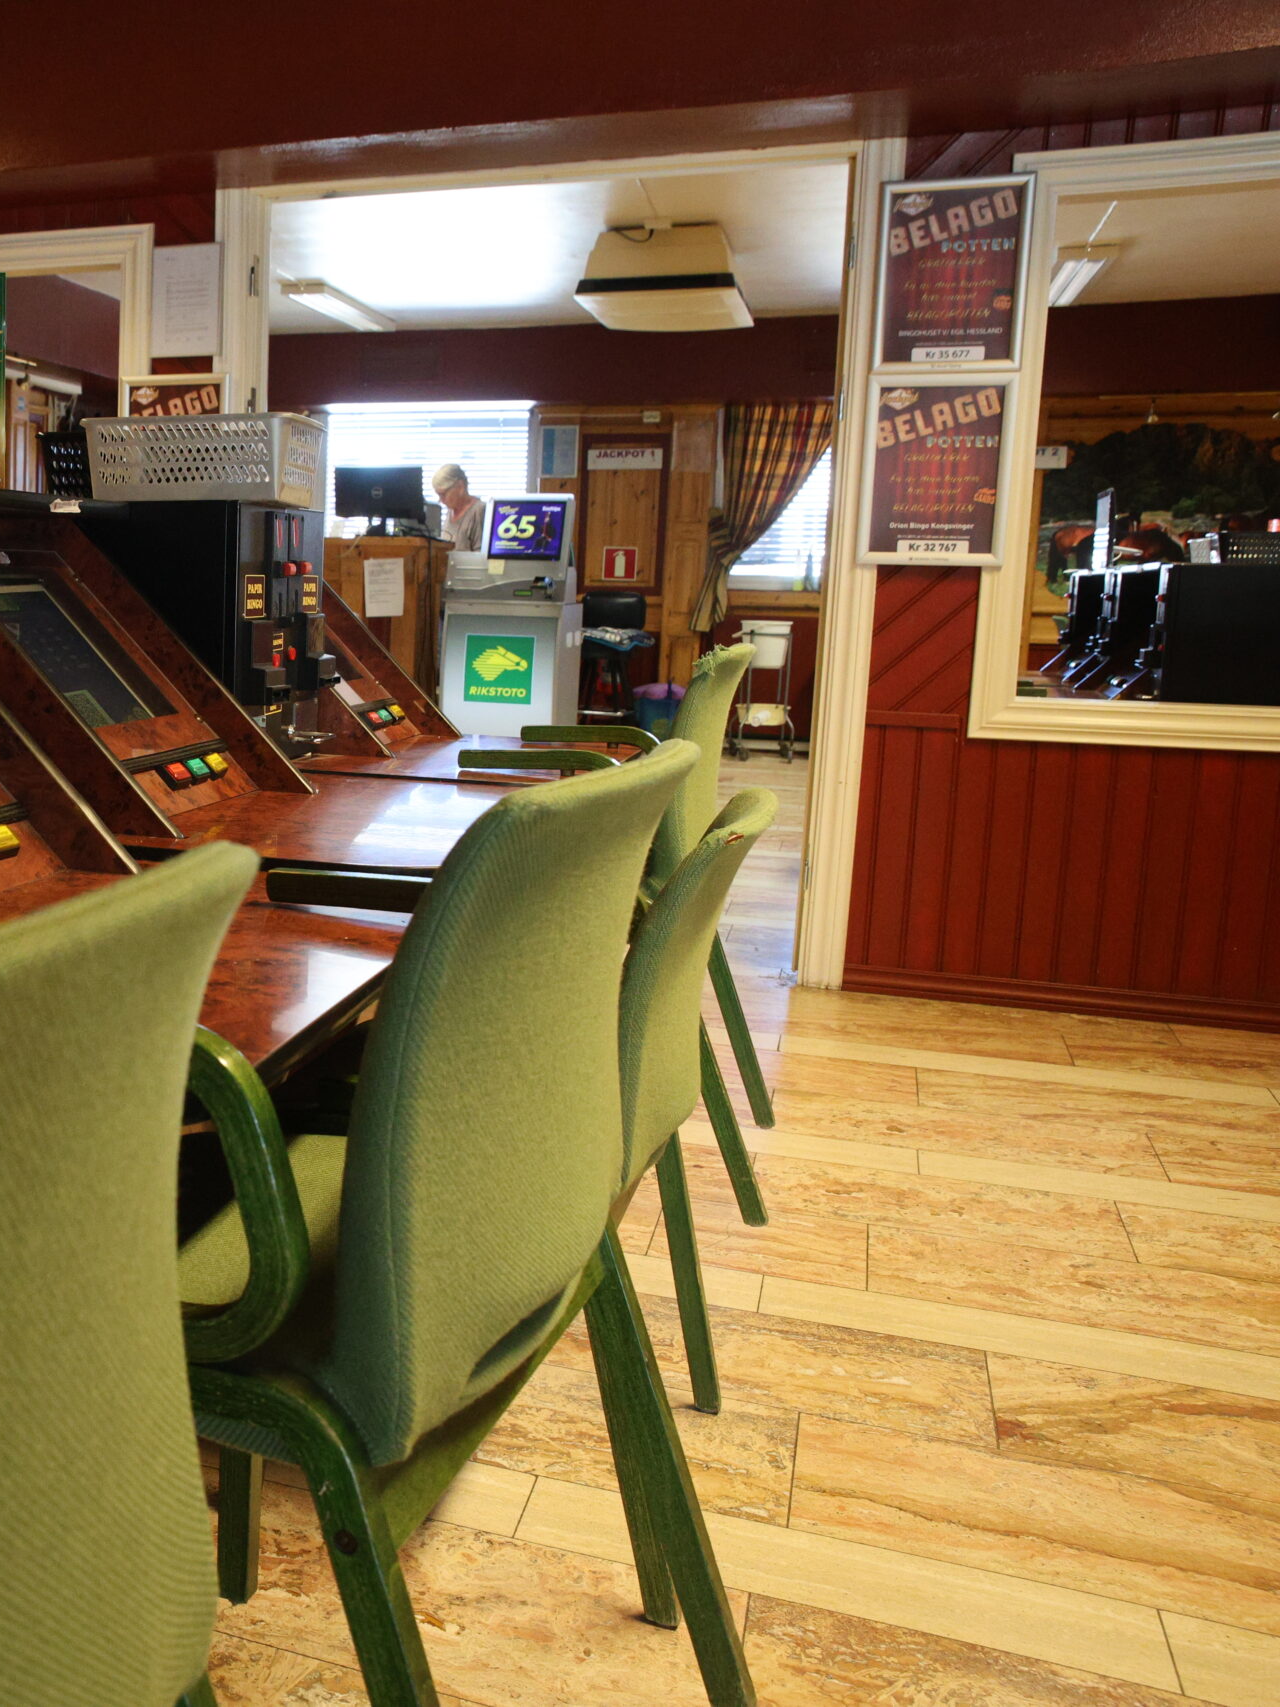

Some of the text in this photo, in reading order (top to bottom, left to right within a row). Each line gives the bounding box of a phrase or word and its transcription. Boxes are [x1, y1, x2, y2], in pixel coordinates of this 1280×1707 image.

[889, 188, 1018, 257] BELAGO
[940, 236, 1016, 253] POTTEN
[925, 350, 970, 360] Kr 35 677
[876, 387, 1002, 450] BELAGO
[926, 435, 998, 448] POTTEN
[596, 450, 646, 458] JACKPOT
[1051, 448, 1059, 456] 2
[497, 514, 537, 540] 65
[910, 522, 930, 530] Bingo
[930, 522, 974, 531] Kongsvinger
[908, 543, 957, 552] Kr 32 767
[248, 584, 262, 594] PAPIR
[304, 582, 316, 592] PAPIR
[246, 599, 262, 610] BINGO
[302, 596, 316, 606] BINGO
[468, 686, 527, 698] RIKSTOTO
